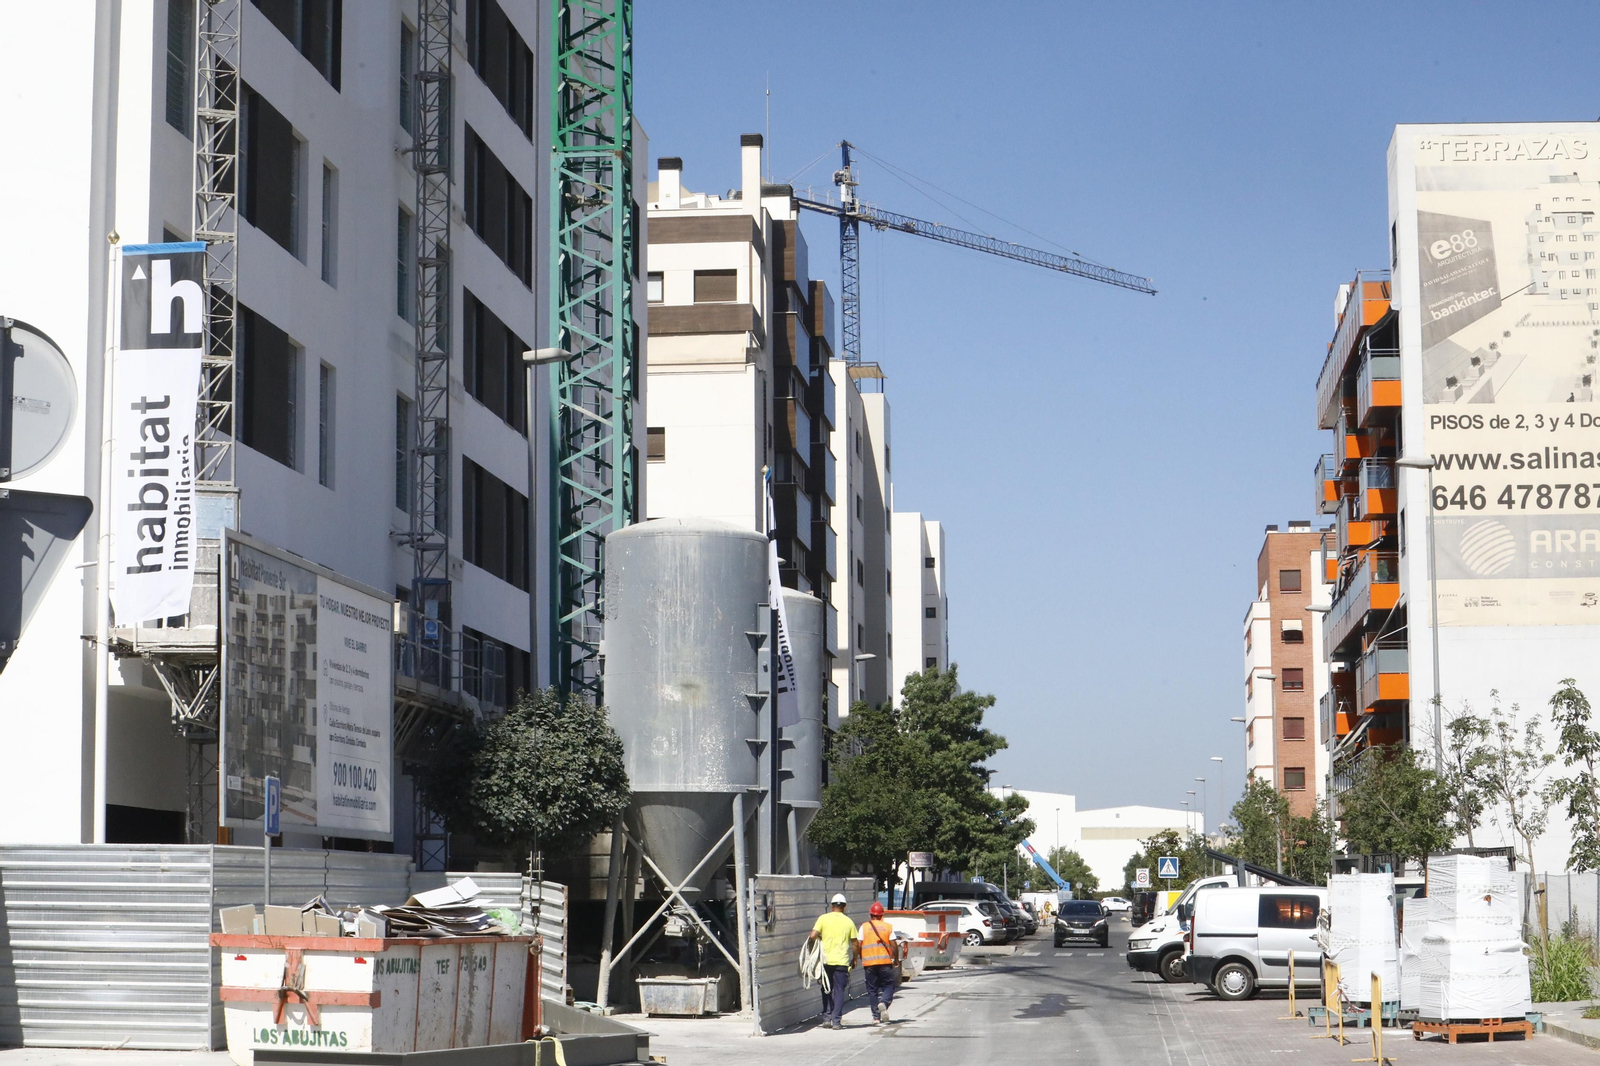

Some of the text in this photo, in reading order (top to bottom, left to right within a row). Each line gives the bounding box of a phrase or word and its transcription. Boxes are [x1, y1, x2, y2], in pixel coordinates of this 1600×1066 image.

[1430, 230, 1477, 260] e88
[1437, 246, 1482, 268] ARQUITECTURA
[1428, 294, 1455, 309] FINANCIADO
[1430, 415, 1484, 430] PISOS
[1490, 415, 1510, 429] de
[1515, 414, 1529, 431] 2,
[1535, 414, 1544, 428] 3
[1550, 417, 1559, 432] y
[1564, 413, 1575, 428] 4
[1431, 447, 1600, 470] www.salina
[127, 395, 170, 574] habitat
[168, 434, 191, 570] inmobiliaria
[1432, 485, 1486, 510] 646
[1530, 529, 1600, 552] ARA
[1531, 559, 1595, 568] CONST
[320, 595, 325, 608] TU
[341, 603, 358, 620] NUESTRO
[359, 610, 371, 625] MEJOR
[372, 614, 390, 631] PROYECTO
[333, 762, 377, 792] 900 100 420
[436, 959, 450, 975] TEF
[254, 1028, 347, 1047] LOS ABUJITAS
